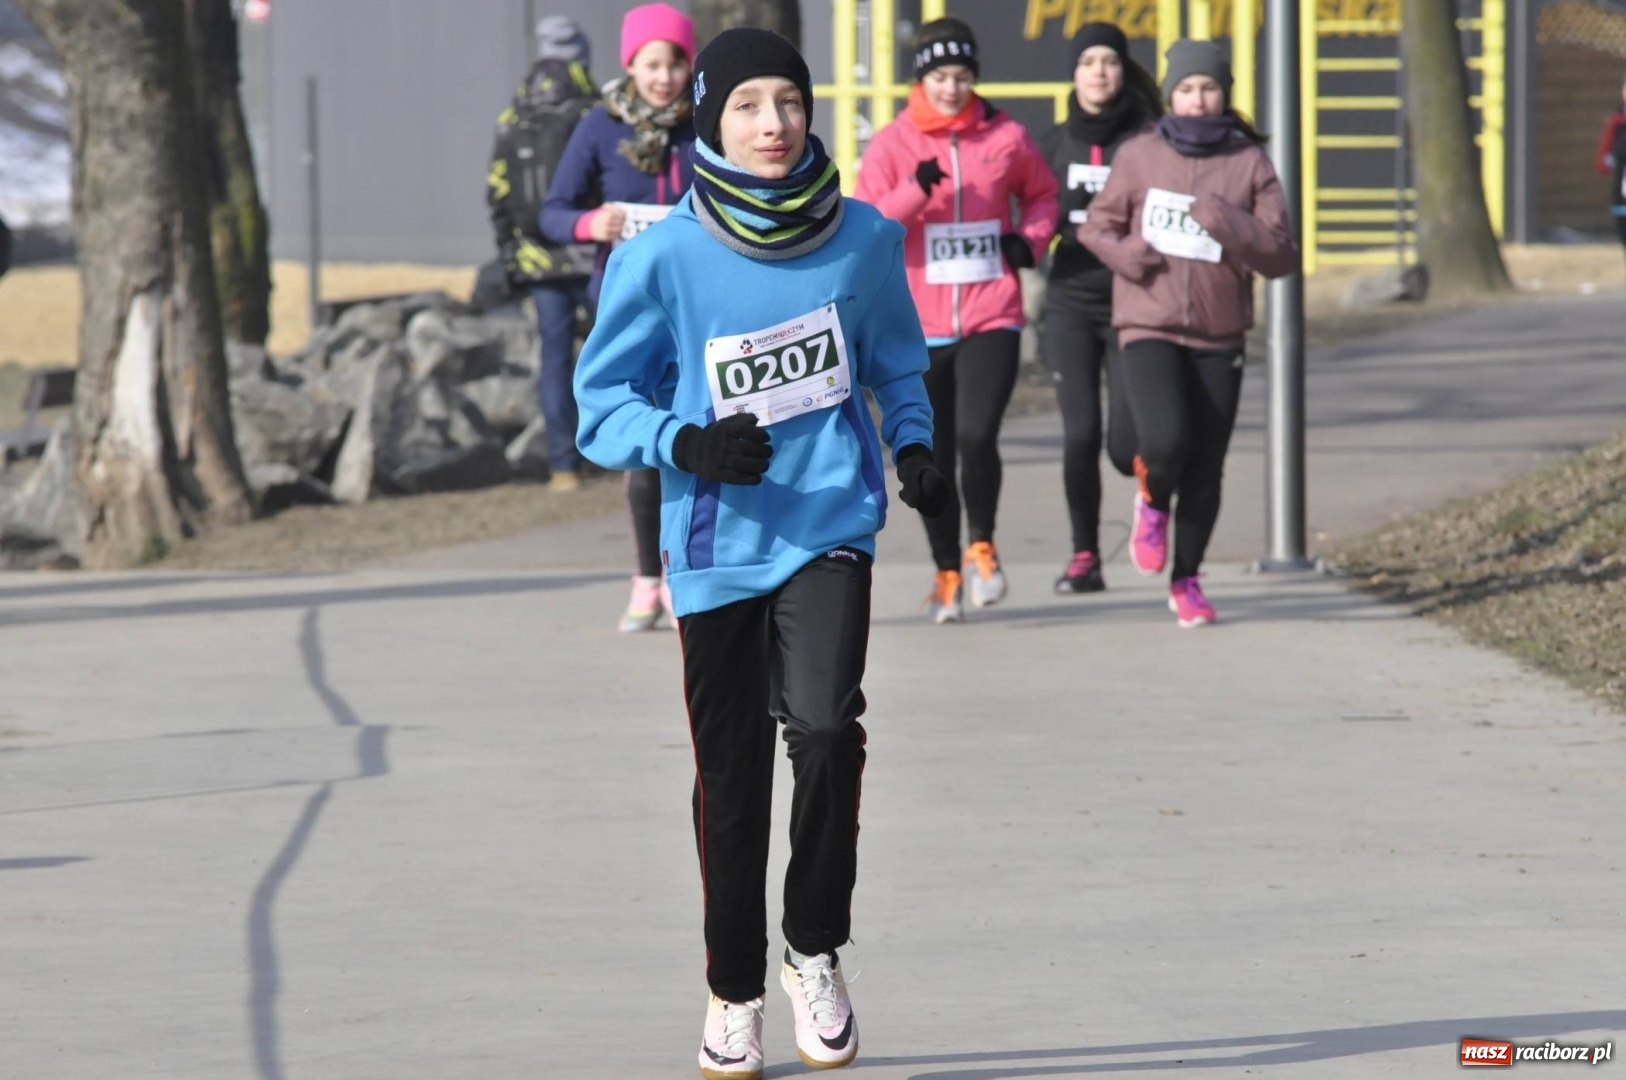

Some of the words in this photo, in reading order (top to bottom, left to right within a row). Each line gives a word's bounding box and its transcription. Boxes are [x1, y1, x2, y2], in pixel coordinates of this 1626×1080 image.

[1151, 207, 1208, 237] 016
[935, 237, 993, 260] 0121
[725, 333, 830, 395] 0207
